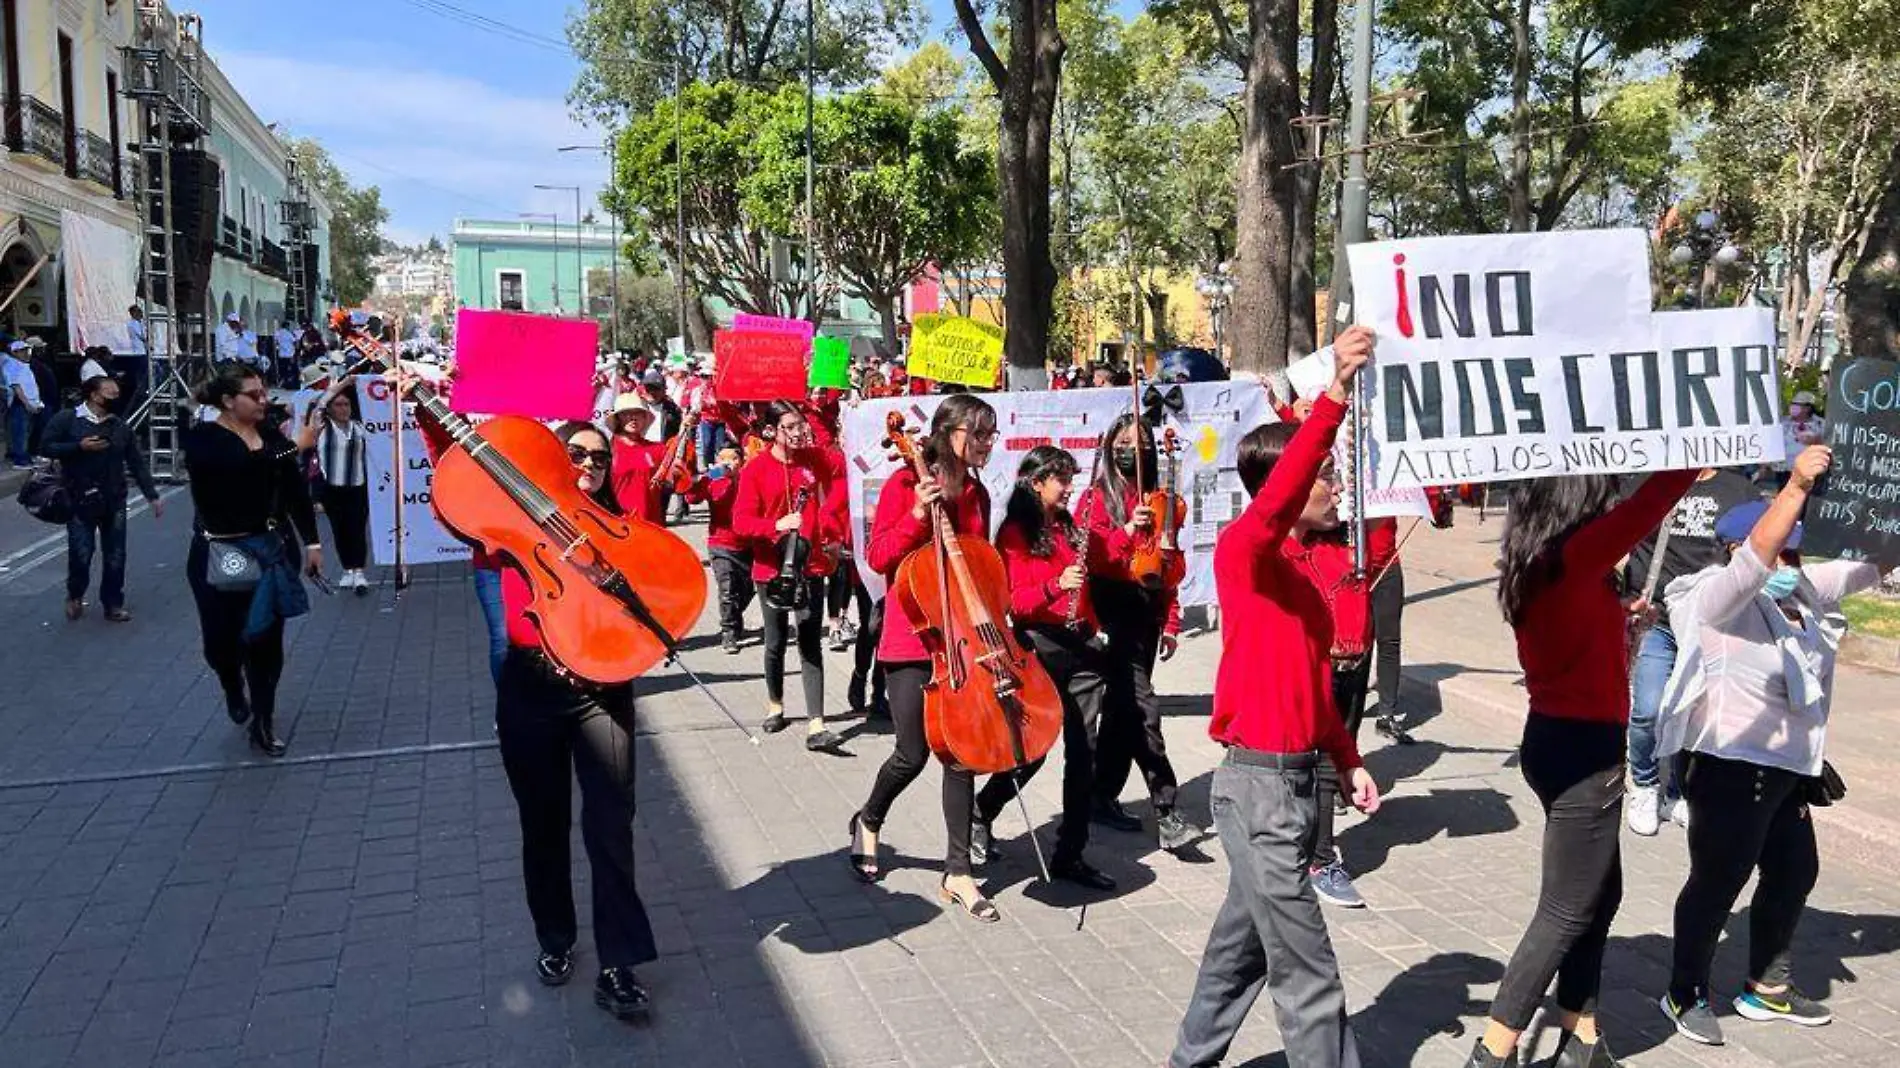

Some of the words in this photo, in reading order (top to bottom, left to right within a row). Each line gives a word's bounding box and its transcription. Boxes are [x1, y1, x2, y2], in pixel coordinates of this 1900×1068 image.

[1382, 356, 1546, 443] NOS
[1560, 344, 1774, 434] CORR
[1492, 441, 1552, 473] LOS
[1560, 437, 1649, 473] NIÑOS
[1659, 432, 1671, 467] Y
[1683, 429, 1764, 469] NIÑAS
